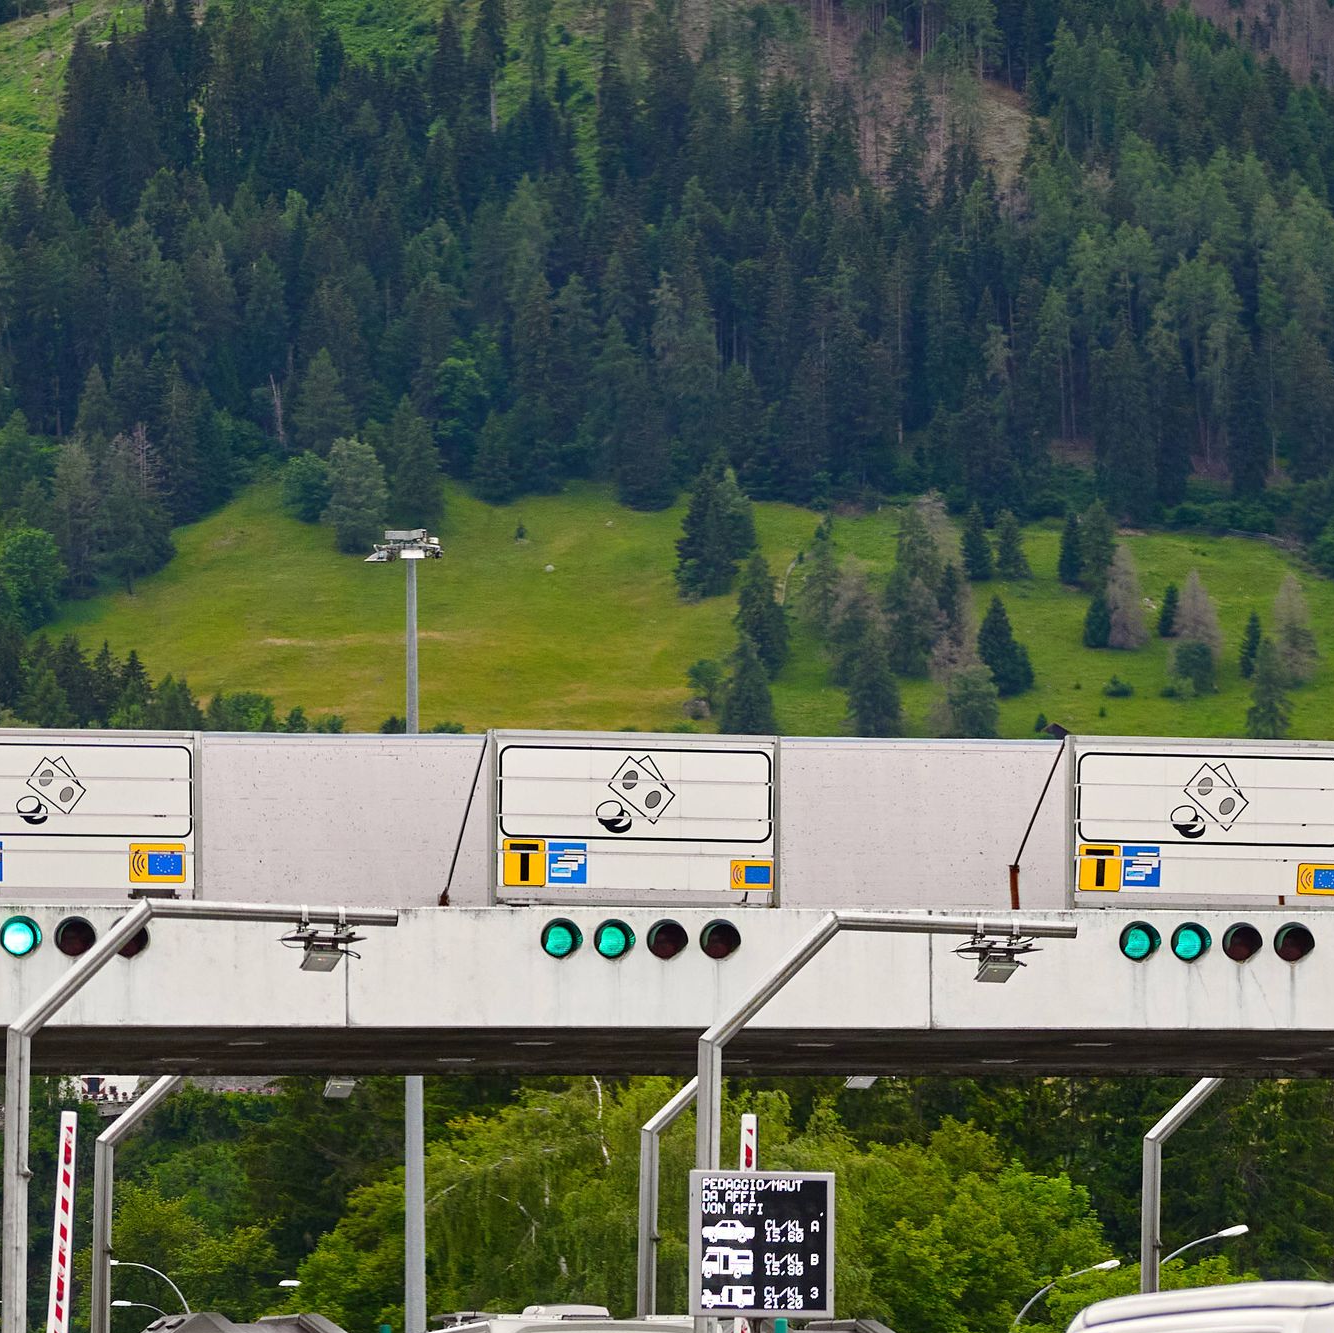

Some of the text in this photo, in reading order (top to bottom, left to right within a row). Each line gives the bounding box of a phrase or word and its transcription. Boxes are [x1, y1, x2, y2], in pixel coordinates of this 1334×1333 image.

[510, 844, 539, 881] T
[1085, 849, 1114, 886] T
[702, 1178, 803, 1192] PEDAGGIO/MAUT
[702, 1190, 756, 1202] DA AFFI
[702, 1202, 764, 1215] VON AFFI
[764, 1219, 820, 1233] CL/KL A
[764, 1252, 819, 1266] CL/KL B
[764, 1286, 819, 1299] CL/KL 3
[764, 1297, 804, 1309] 21,20
